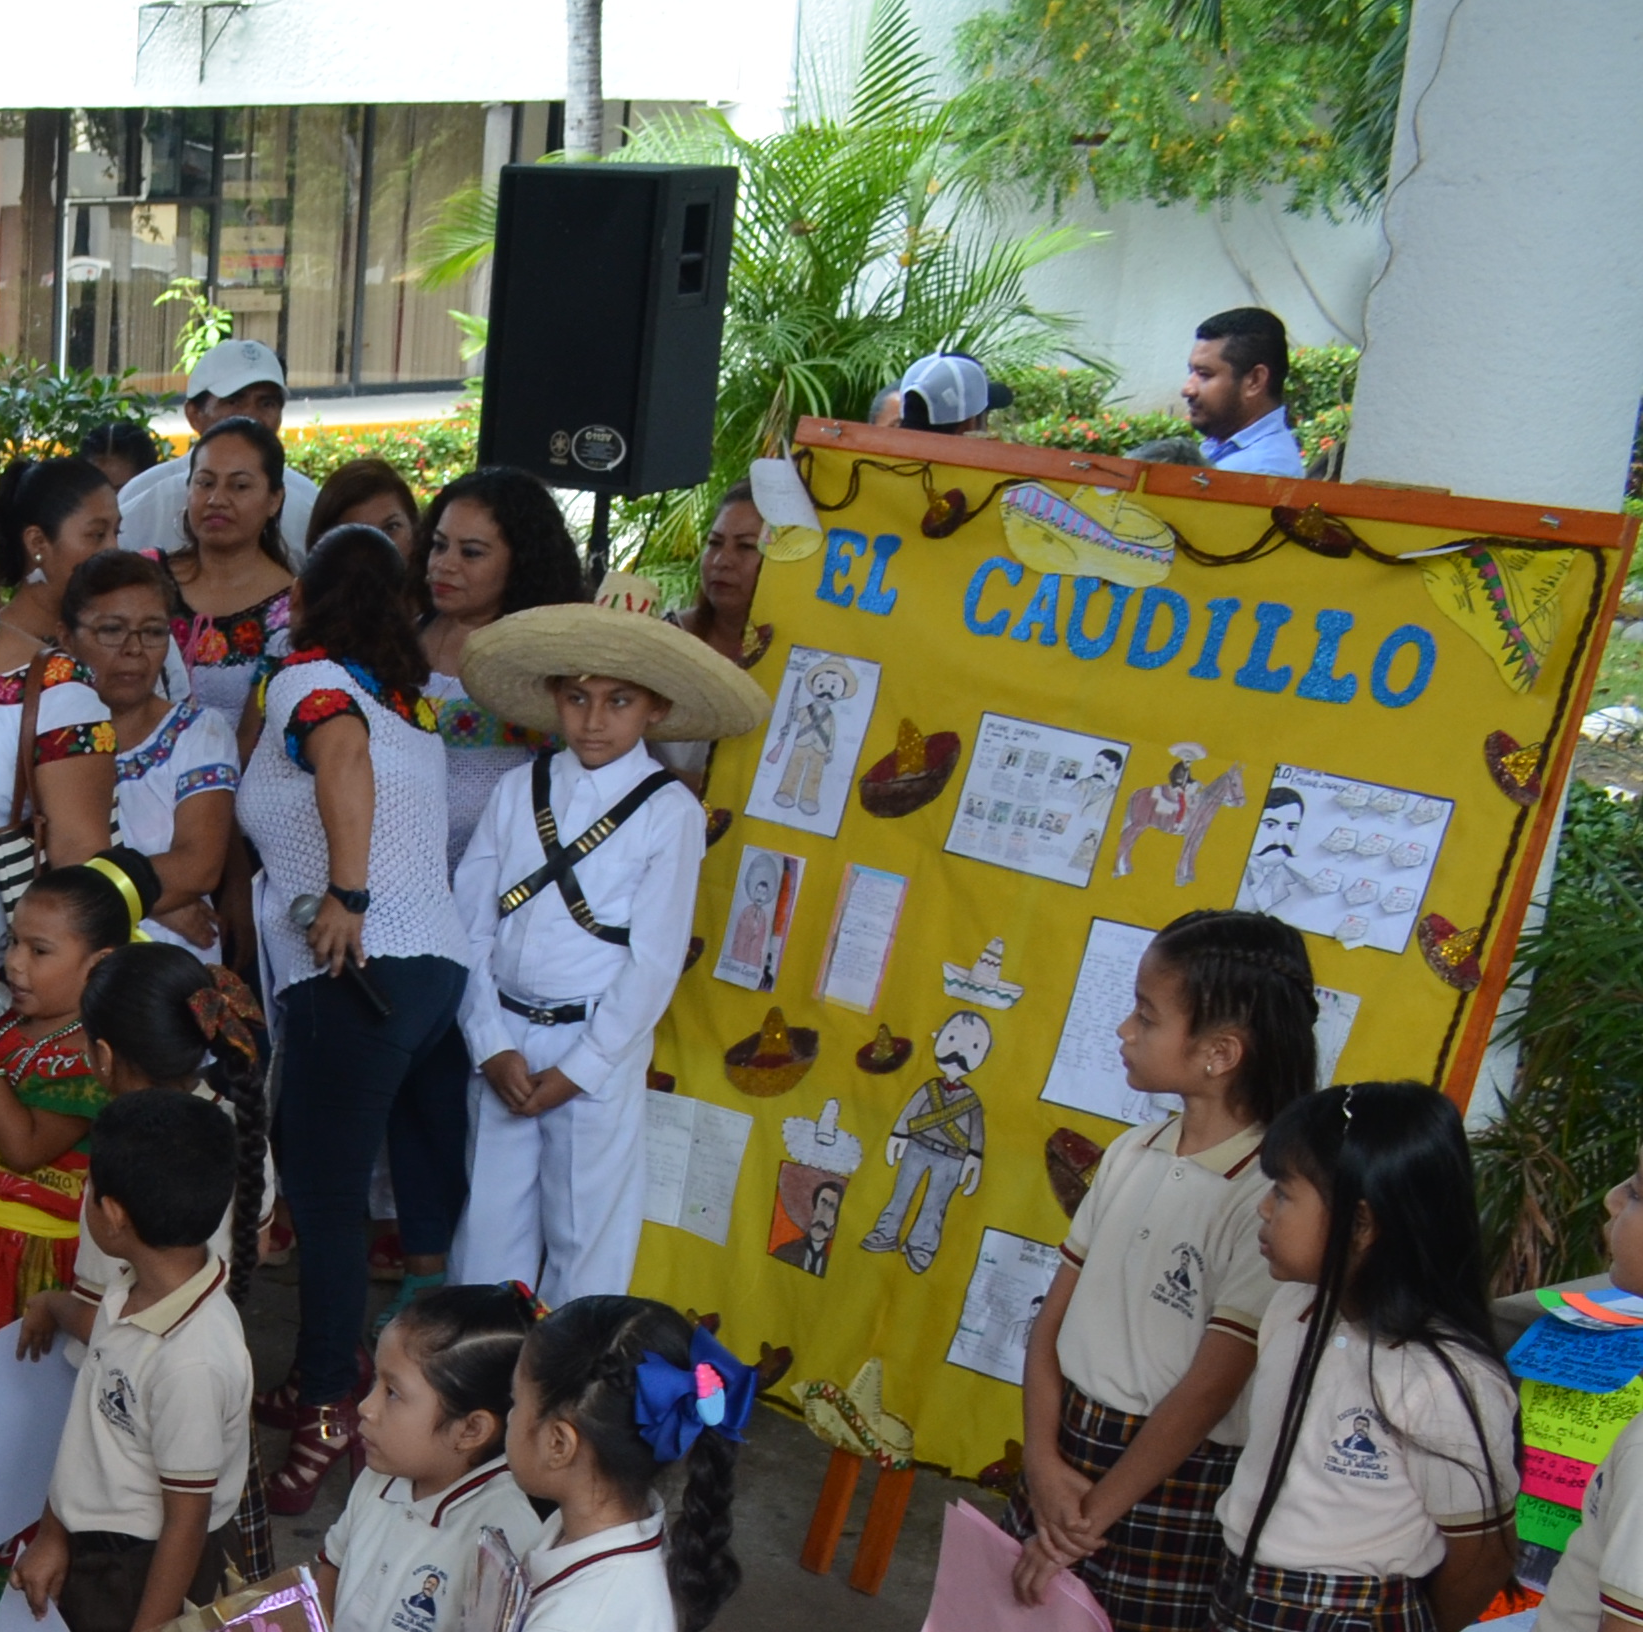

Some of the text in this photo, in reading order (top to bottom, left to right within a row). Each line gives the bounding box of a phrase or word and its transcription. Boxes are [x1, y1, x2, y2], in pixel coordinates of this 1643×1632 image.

[816, 528, 902, 616] EL
[963, 556, 1437, 709] CAUDILLO
[1323, 1462, 1389, 1480] TURNO MATUTINO
